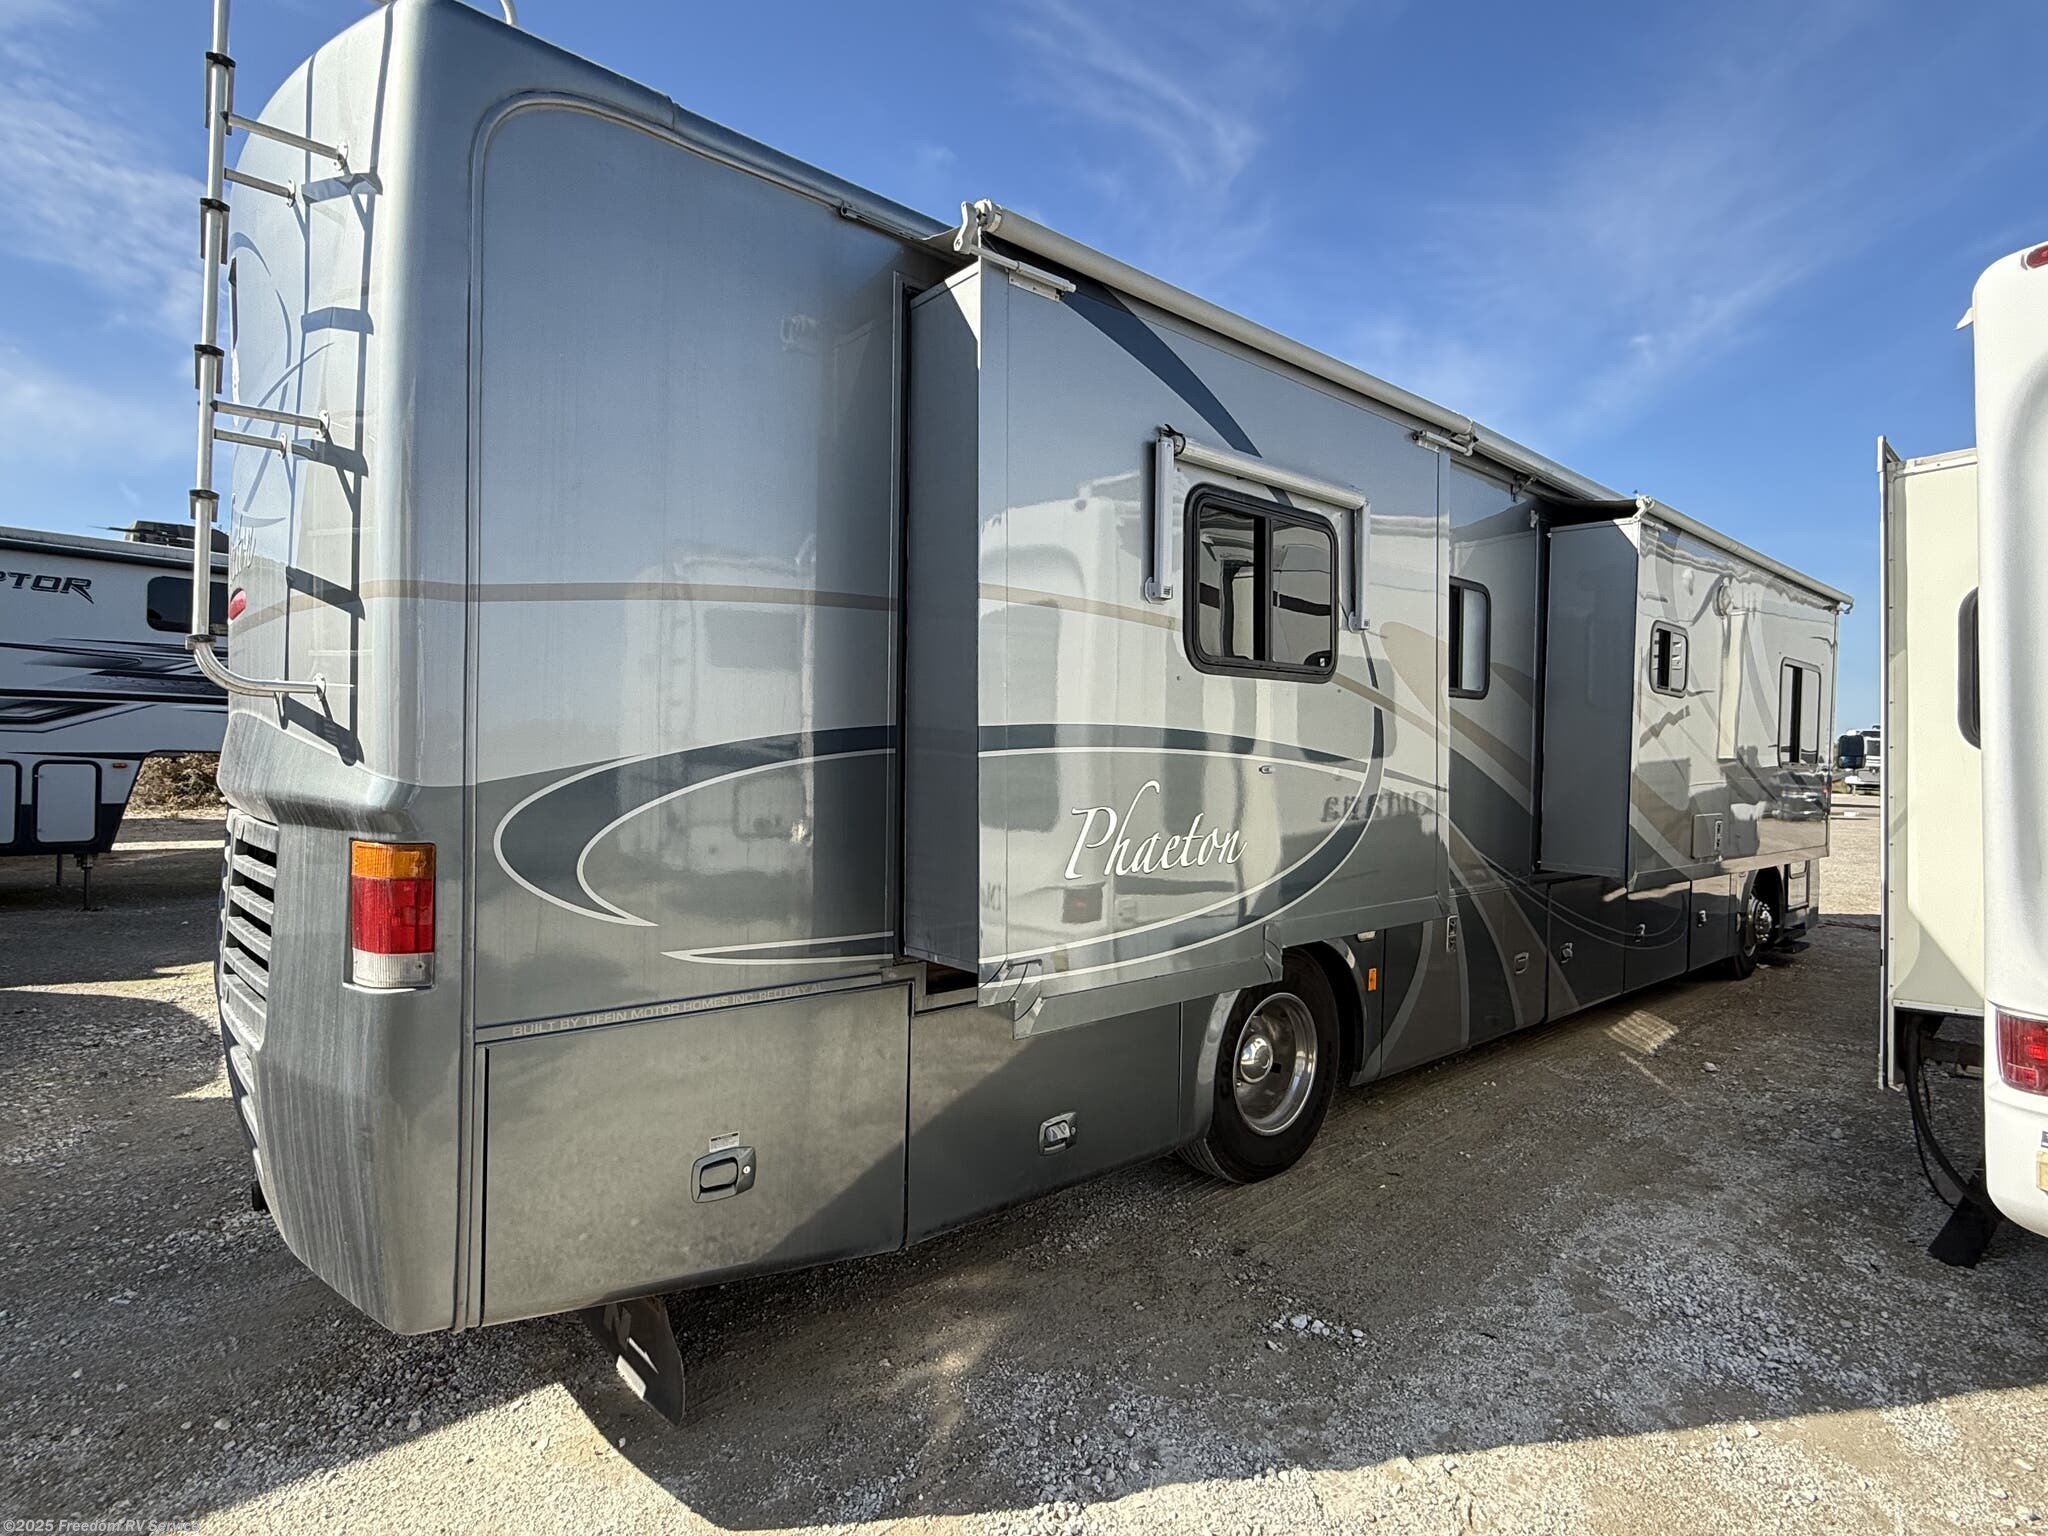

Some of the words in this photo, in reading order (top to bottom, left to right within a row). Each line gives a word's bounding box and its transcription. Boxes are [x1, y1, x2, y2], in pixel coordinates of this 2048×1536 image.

[1064, 779, 1248, 880] Phaeton
[512, 1022, 556, 1036] BUILT
[560, 1016, 580, 1031] BY
[584, 1010, 627, 1026] TIFFIN
[631, 1002, 680, 1019] MOTOR
[683, 997, 729, 1011] HOMES
